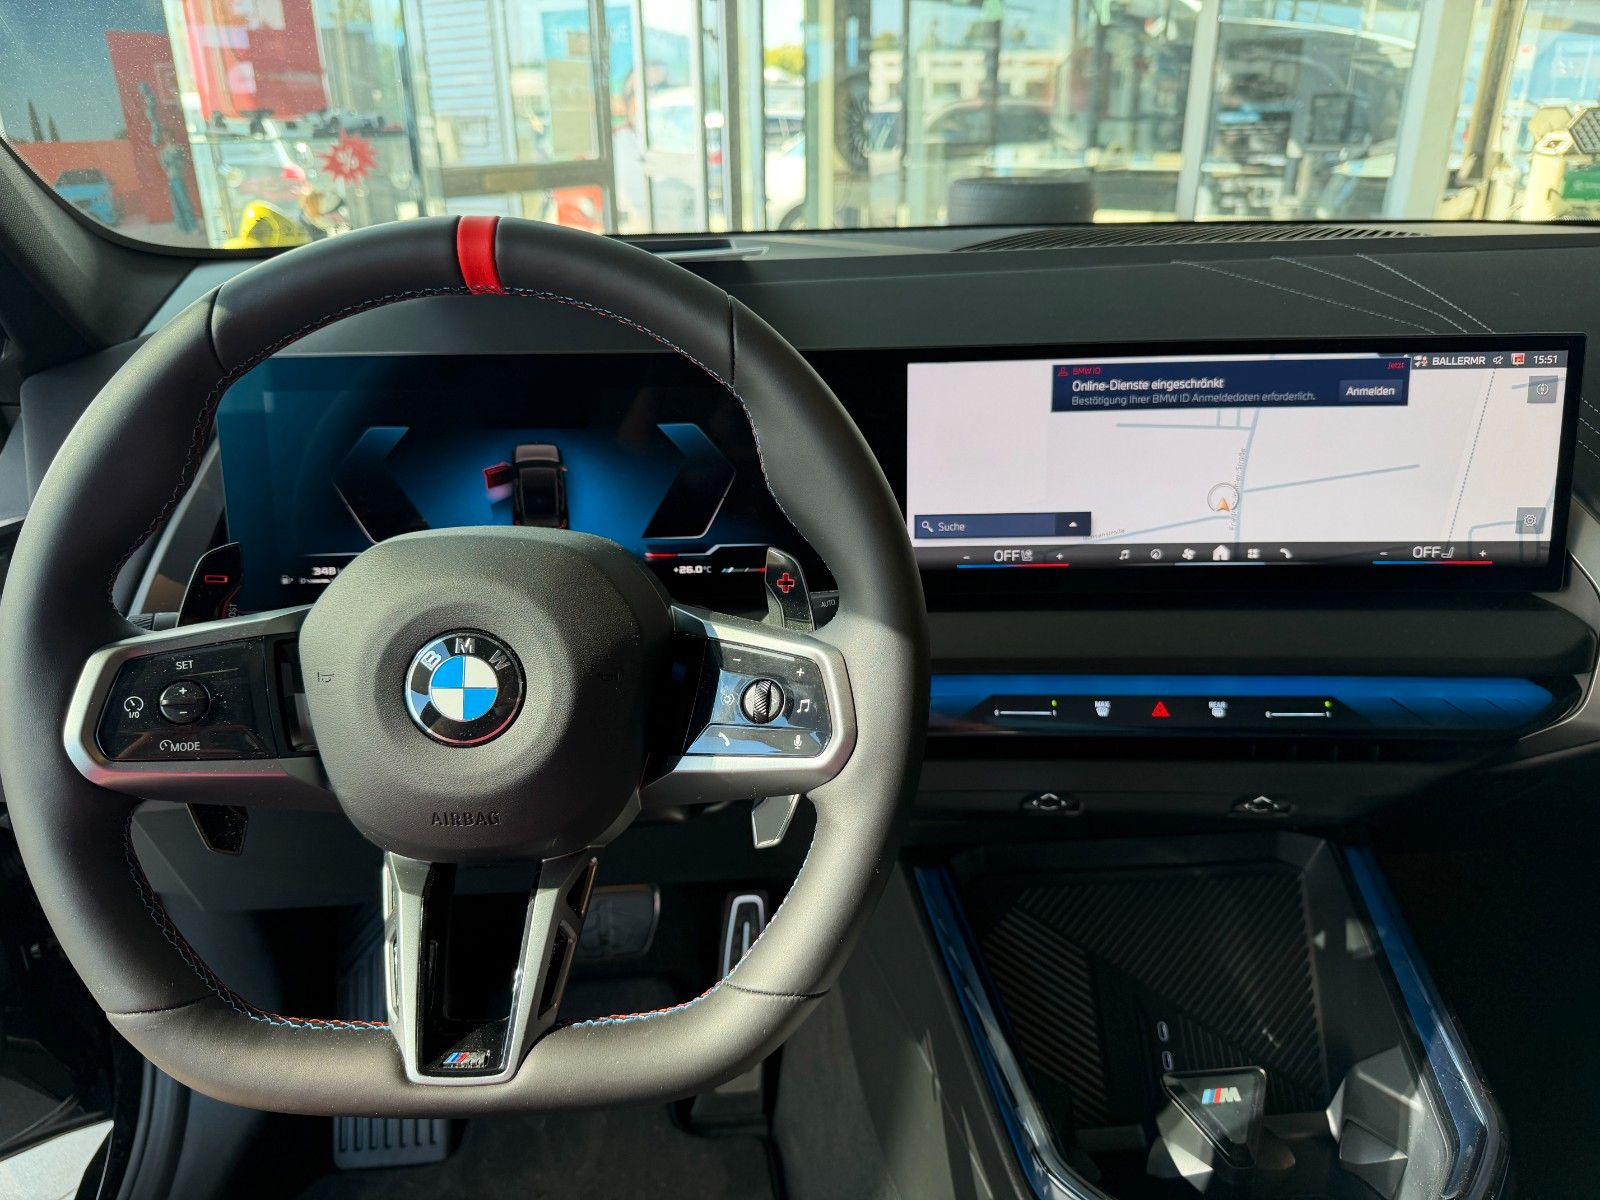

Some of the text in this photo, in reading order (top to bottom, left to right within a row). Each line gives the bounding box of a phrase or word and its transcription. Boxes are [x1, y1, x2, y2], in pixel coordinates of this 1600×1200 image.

[1432, 356, 1486, 366] BALLERMR
[1533, 355, 1558, 364] 15:51
[1072, 367, 1101, 376] BMW ID
[1072, 377, 1225, 392] Online-Dienste eingeschränkt
[1346, 386, 1395, 396] Anmelden
[1071, 391, 1316, 406] Bestätigung Ihrer BMW ID Anmeldedaten erforderlich.
[938, 521, 966, 532] Suche
[993, 550, 1020, 562] OFF
[1412, 547, 1441, 559] OFF
[820, 600, 836, 608] AUTO
[420, 637, 511, 672] BMW
[175, 660, 194, 670] SET
[171, 741, 201, 752] MODE
[431, 811, 501, 827] AIRBAG
